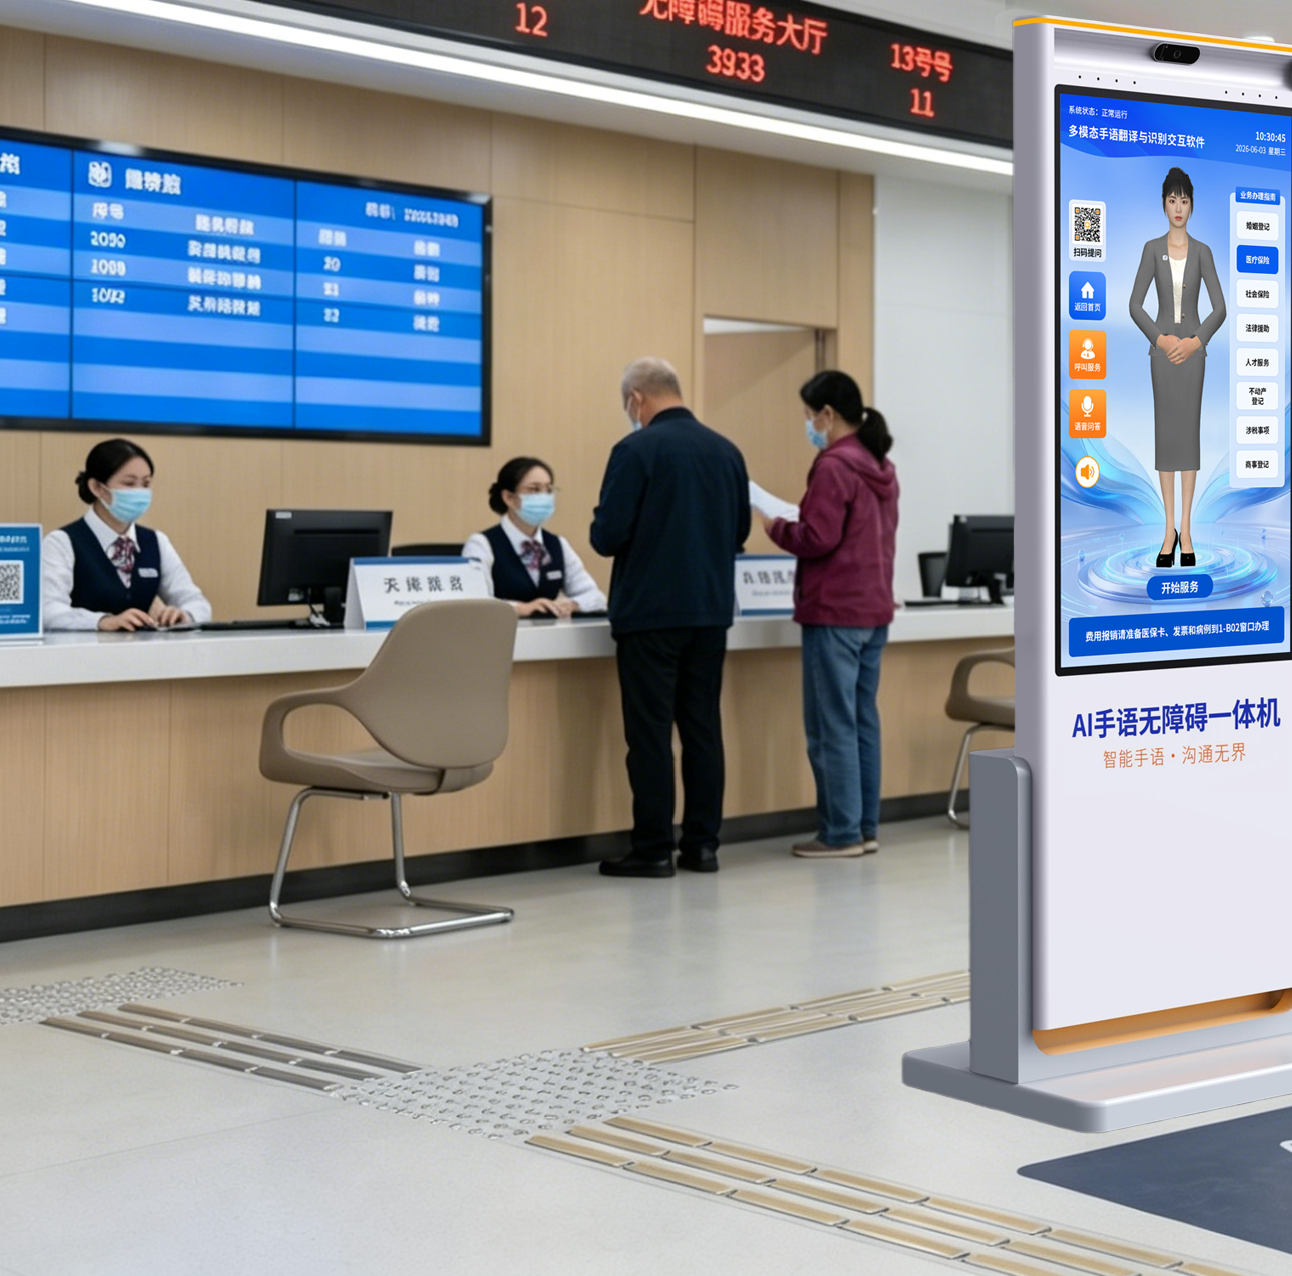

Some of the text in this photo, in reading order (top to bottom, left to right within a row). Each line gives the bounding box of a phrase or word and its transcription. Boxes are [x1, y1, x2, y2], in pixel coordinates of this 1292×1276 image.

[515, 2, 548, 37] 12
[705, 45, 766, 83] 3933
[910, 87, 935, 118] 11
[1068, 105, 1128, 120] 系统状态：正常运行
[1068, 124, 1206, 149] 多模态手语翻译与识别交互软件
[1255, 131, 1287, 143] 10:30:45
[1235, 144, 1287, 156] 2026-06-03 星期三
[1245, 221, 1270, 231] 婚姻登记
[1073, 248, 1102, 258] 扫码提问
[1245, 255, 1270, 265] 医疗保险
[1245, 290, 1270, 299] 社会保险
[1074, 302, 1101, 312] 返回首页
[1245, 324, 1270, 333] 法律援助
[1074, 363, 1101, 372] 呼叫服务
[1245, 358, 1270, 367] 人才服务
[1249, 387, 1267, 395] 不动产
[1251, 397, 1265, 405] 登记
[1074, 422, 1101, 431] 语音问答
[1245, 426, 1270, 435] 涉税事项
[1245, 460, 1270, 469] 商事登记
[1161, 581, 1199, 595] 开始服务
[1085, 620, 1270, 642] 费用报销请准备医保卡、发票和病例到1-B02窗口办理
[1072, 697, 1281, 738] AI手语无障碍一体机
